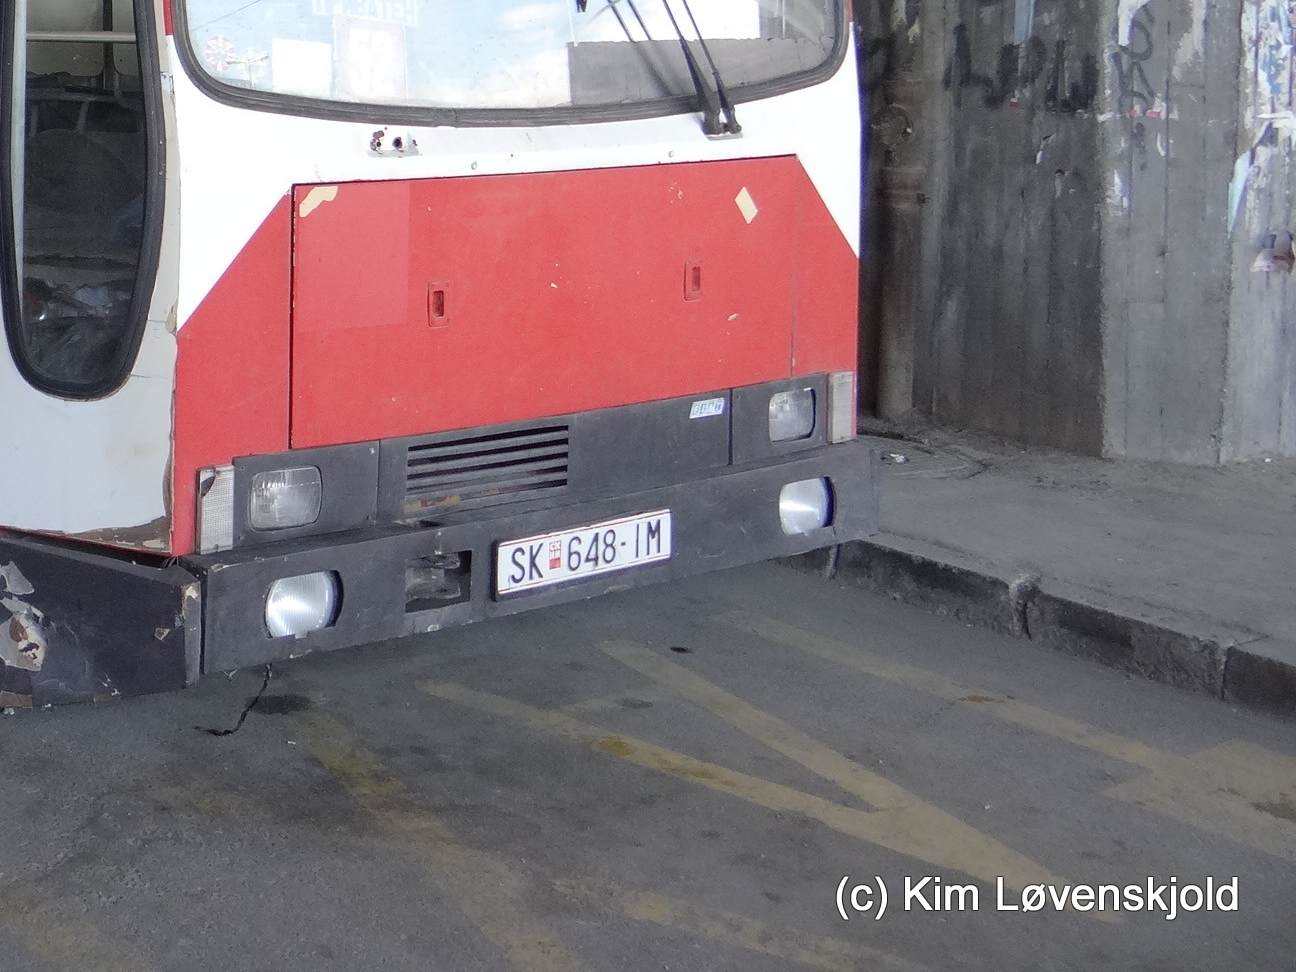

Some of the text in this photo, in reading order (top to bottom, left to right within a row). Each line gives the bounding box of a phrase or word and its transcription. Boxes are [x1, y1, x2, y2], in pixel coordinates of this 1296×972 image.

[349, 27, 395, 97] 52
[510, 519, 661, 584] SK 648-IM
